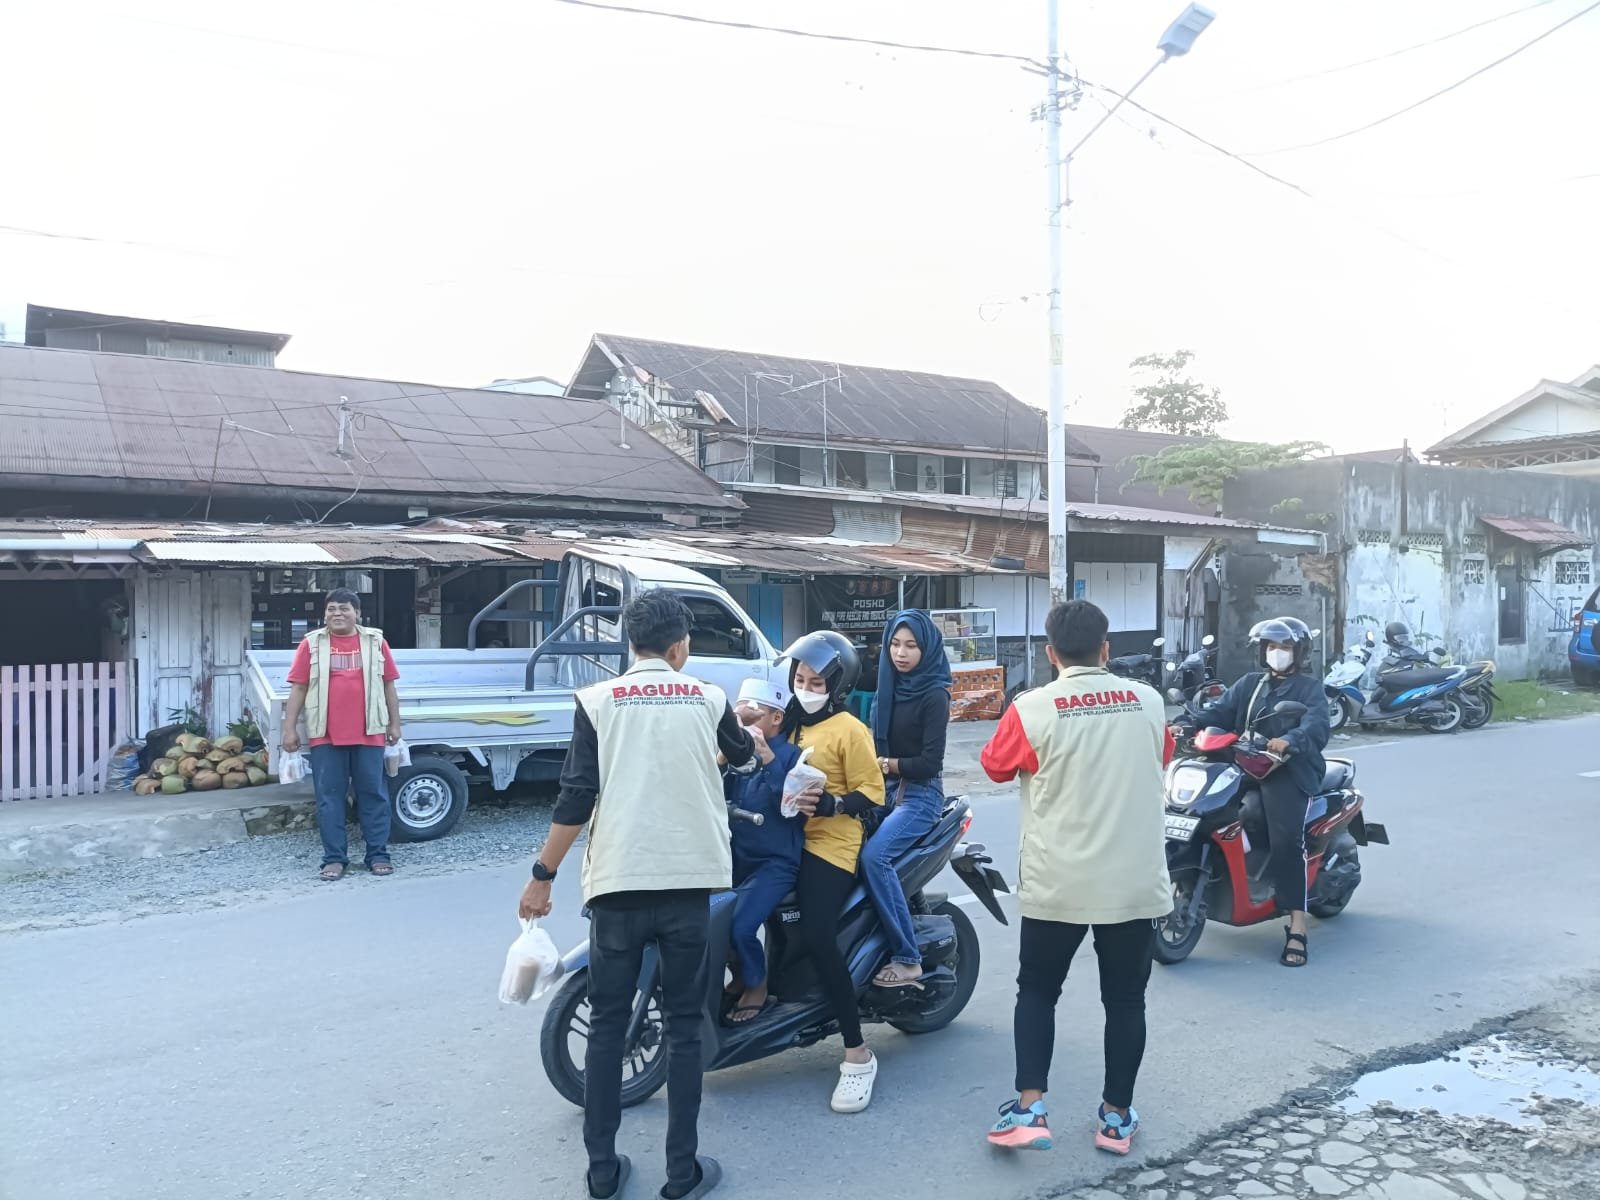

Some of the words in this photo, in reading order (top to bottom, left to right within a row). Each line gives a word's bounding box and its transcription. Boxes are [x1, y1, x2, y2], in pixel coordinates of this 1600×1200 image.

[853, 599, 885, 608] POSKO
[613, 684, 703, 698] BAGUNA
[1054, 690, 1140, 710] BAGUNA
[1083, 708, 1122, 716] PERJUANGAN
